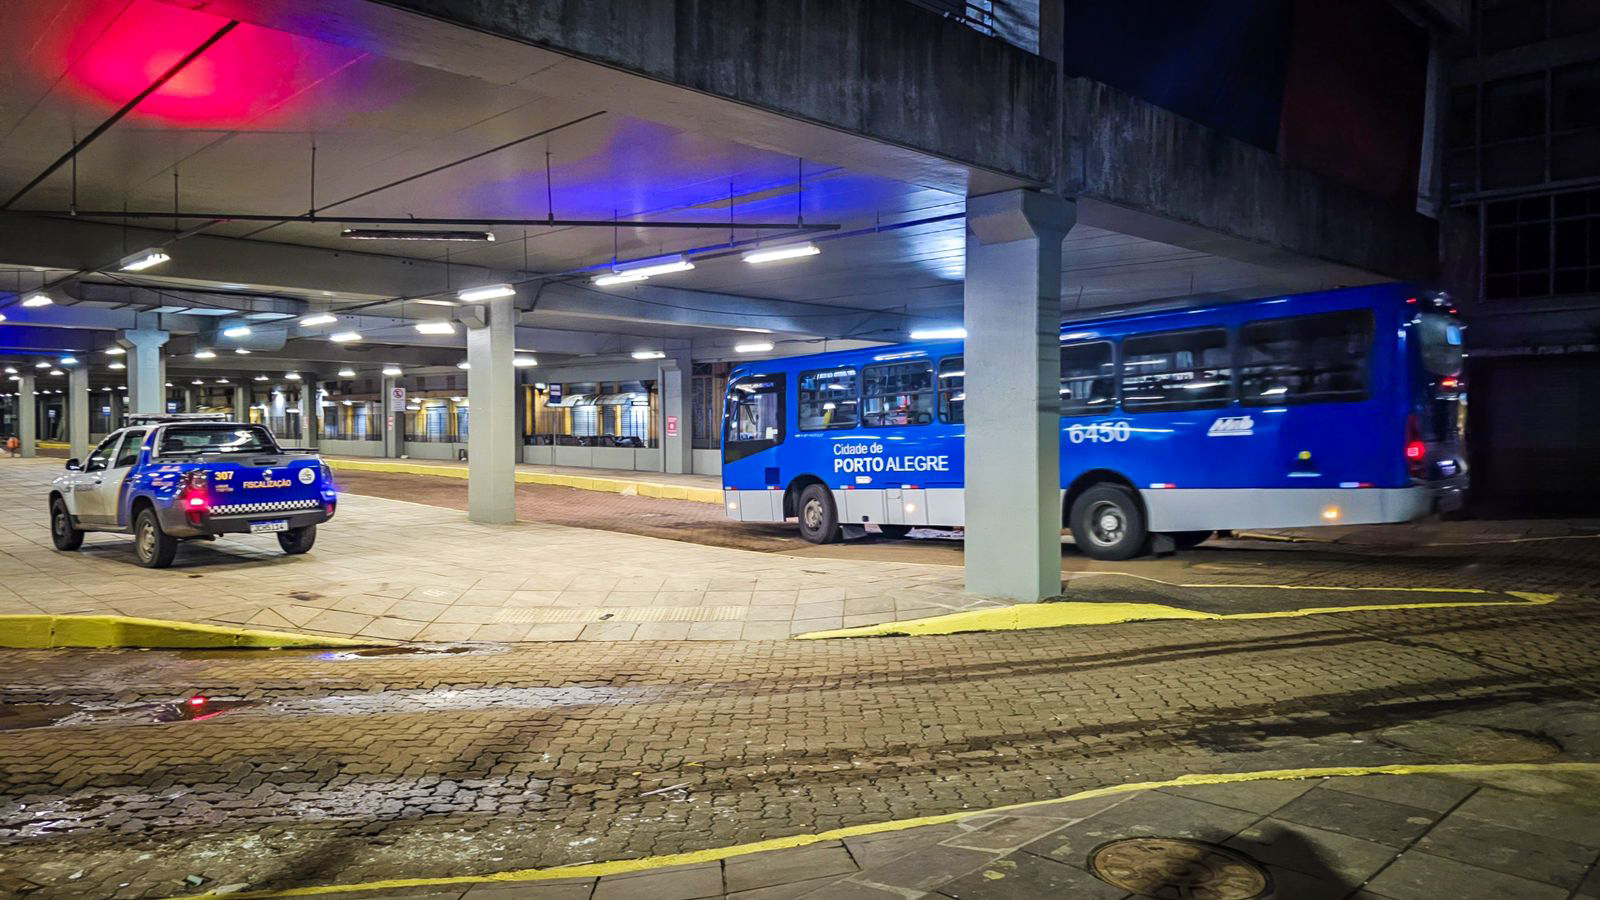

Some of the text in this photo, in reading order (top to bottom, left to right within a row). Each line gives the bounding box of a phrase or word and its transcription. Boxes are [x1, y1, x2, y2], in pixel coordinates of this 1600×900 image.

[1069, 421, 1131, 444] 6450
[833, 442, 883, 455] Cidade de
[834, 455, 949, 473] PORTO ALEGRE
[214, 471, 234, 480] 307
[243, 479, 291, 488] FISCALIZAÇÃO
